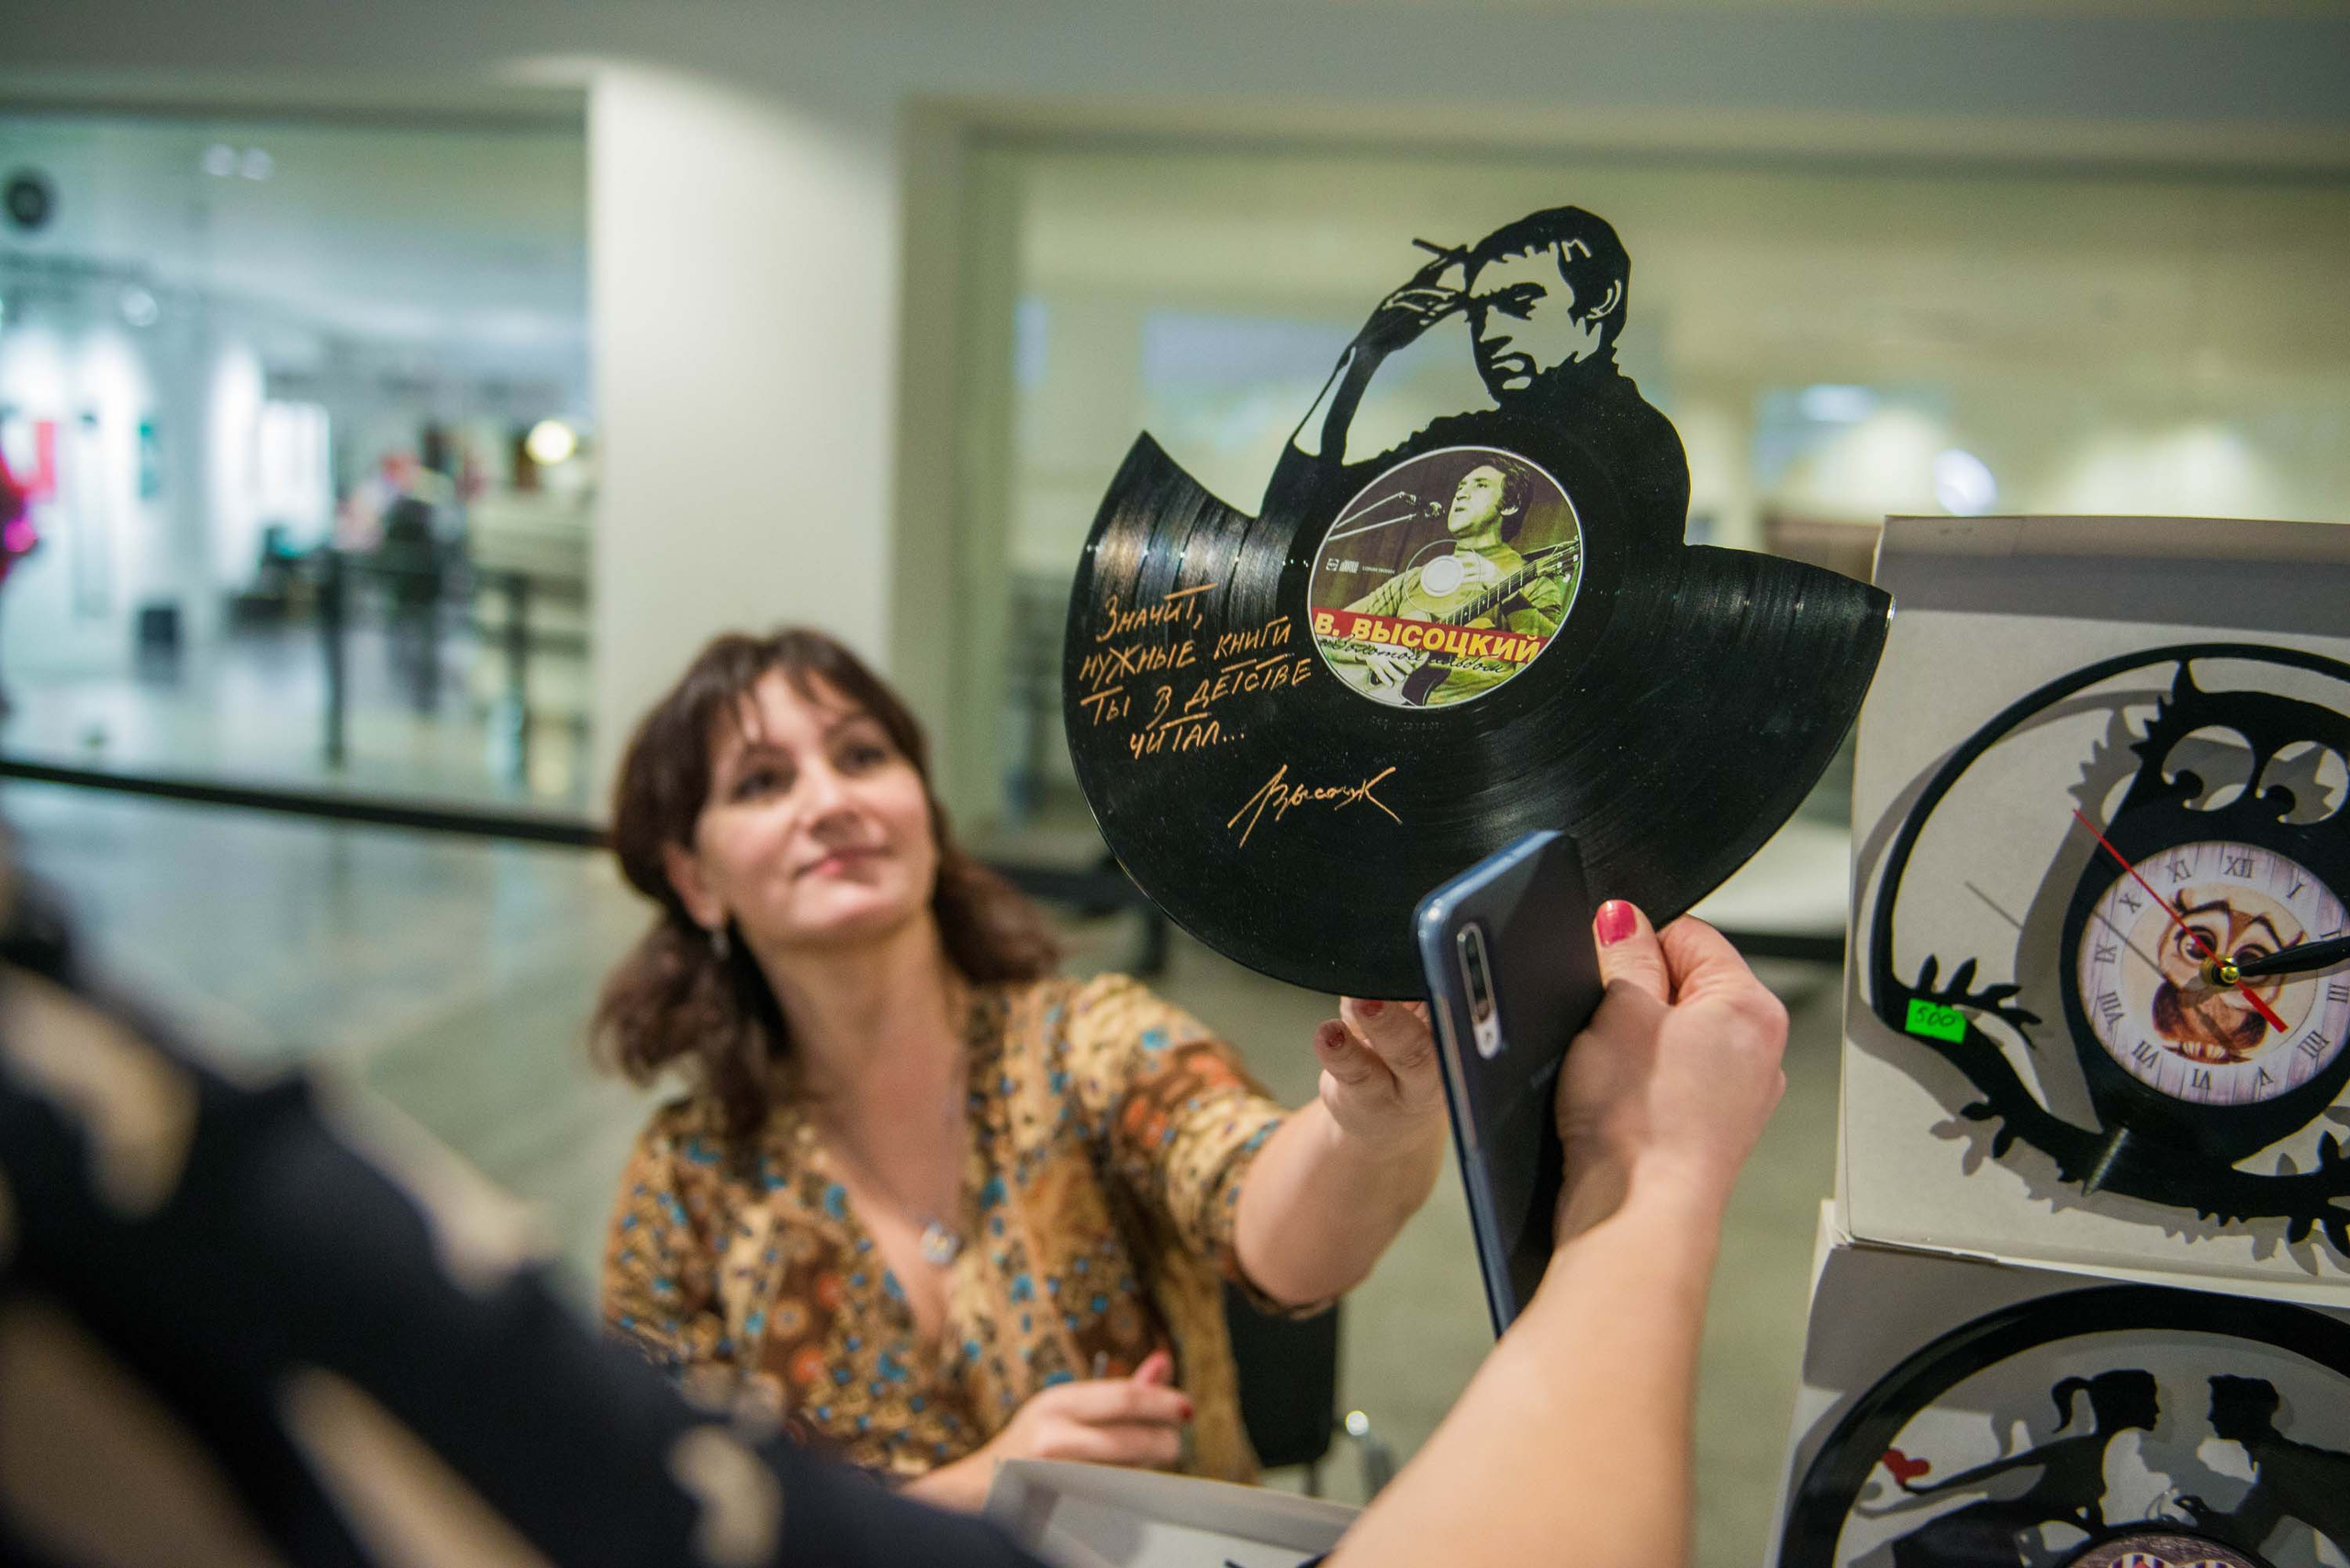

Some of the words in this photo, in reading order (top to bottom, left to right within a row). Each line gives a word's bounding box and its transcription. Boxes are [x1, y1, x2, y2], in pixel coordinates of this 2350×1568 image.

[1314, 612, 1339, 636] В.
[1351, 617, 1540, 664] ВЫСОЦКИЙ
[2224, 855, 2255, 879] XII
[2118, 893, 2143, 914] X
[1915, 1006, 1956, 1026] 500
